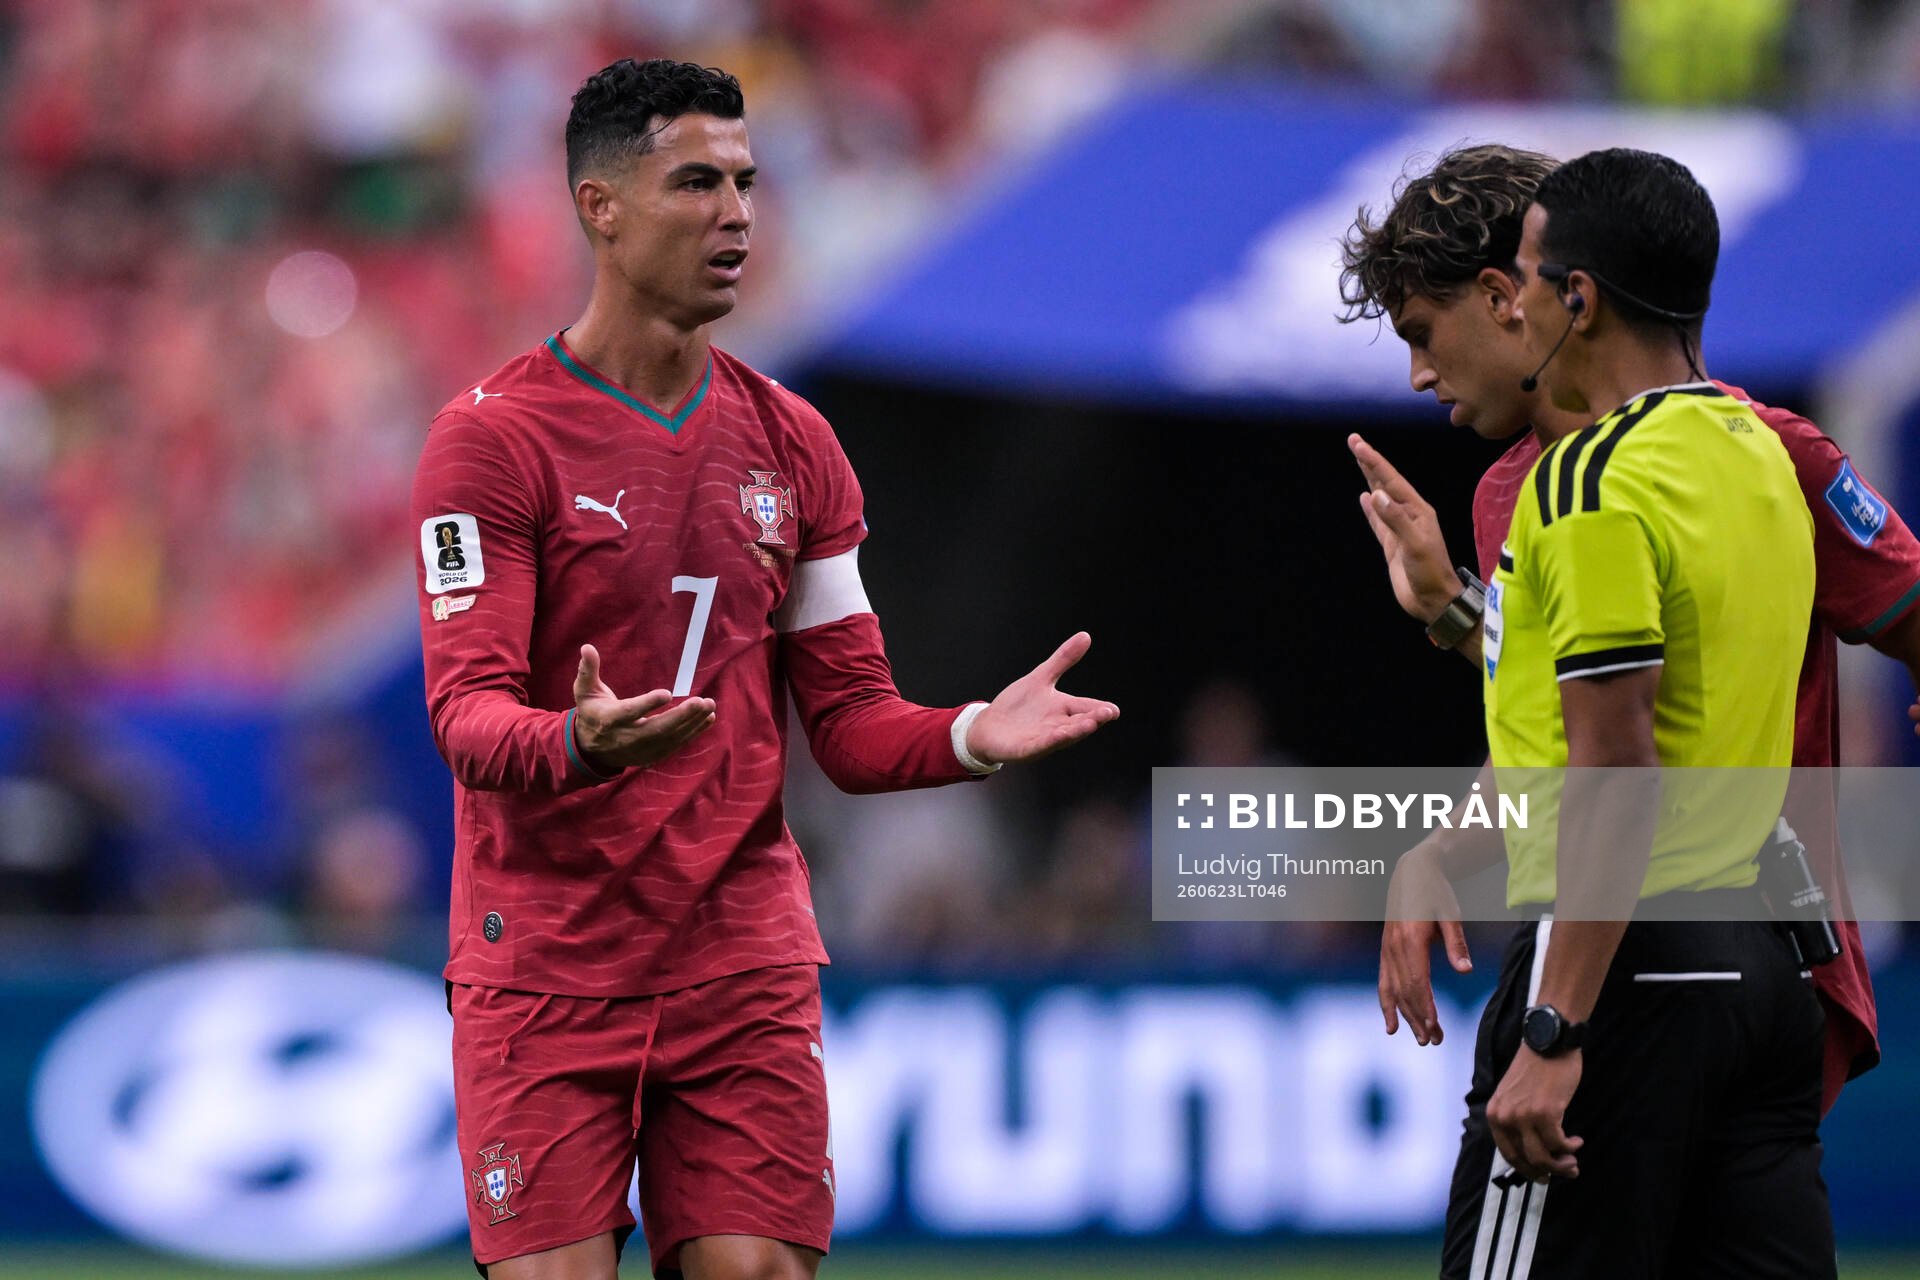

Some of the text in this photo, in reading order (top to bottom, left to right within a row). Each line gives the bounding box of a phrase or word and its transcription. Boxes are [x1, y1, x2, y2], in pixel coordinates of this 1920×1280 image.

[446, 560, 460, 568] FIFA
[440, 576, 468, 586] 2026
[671, 575, 719, 697] 7
